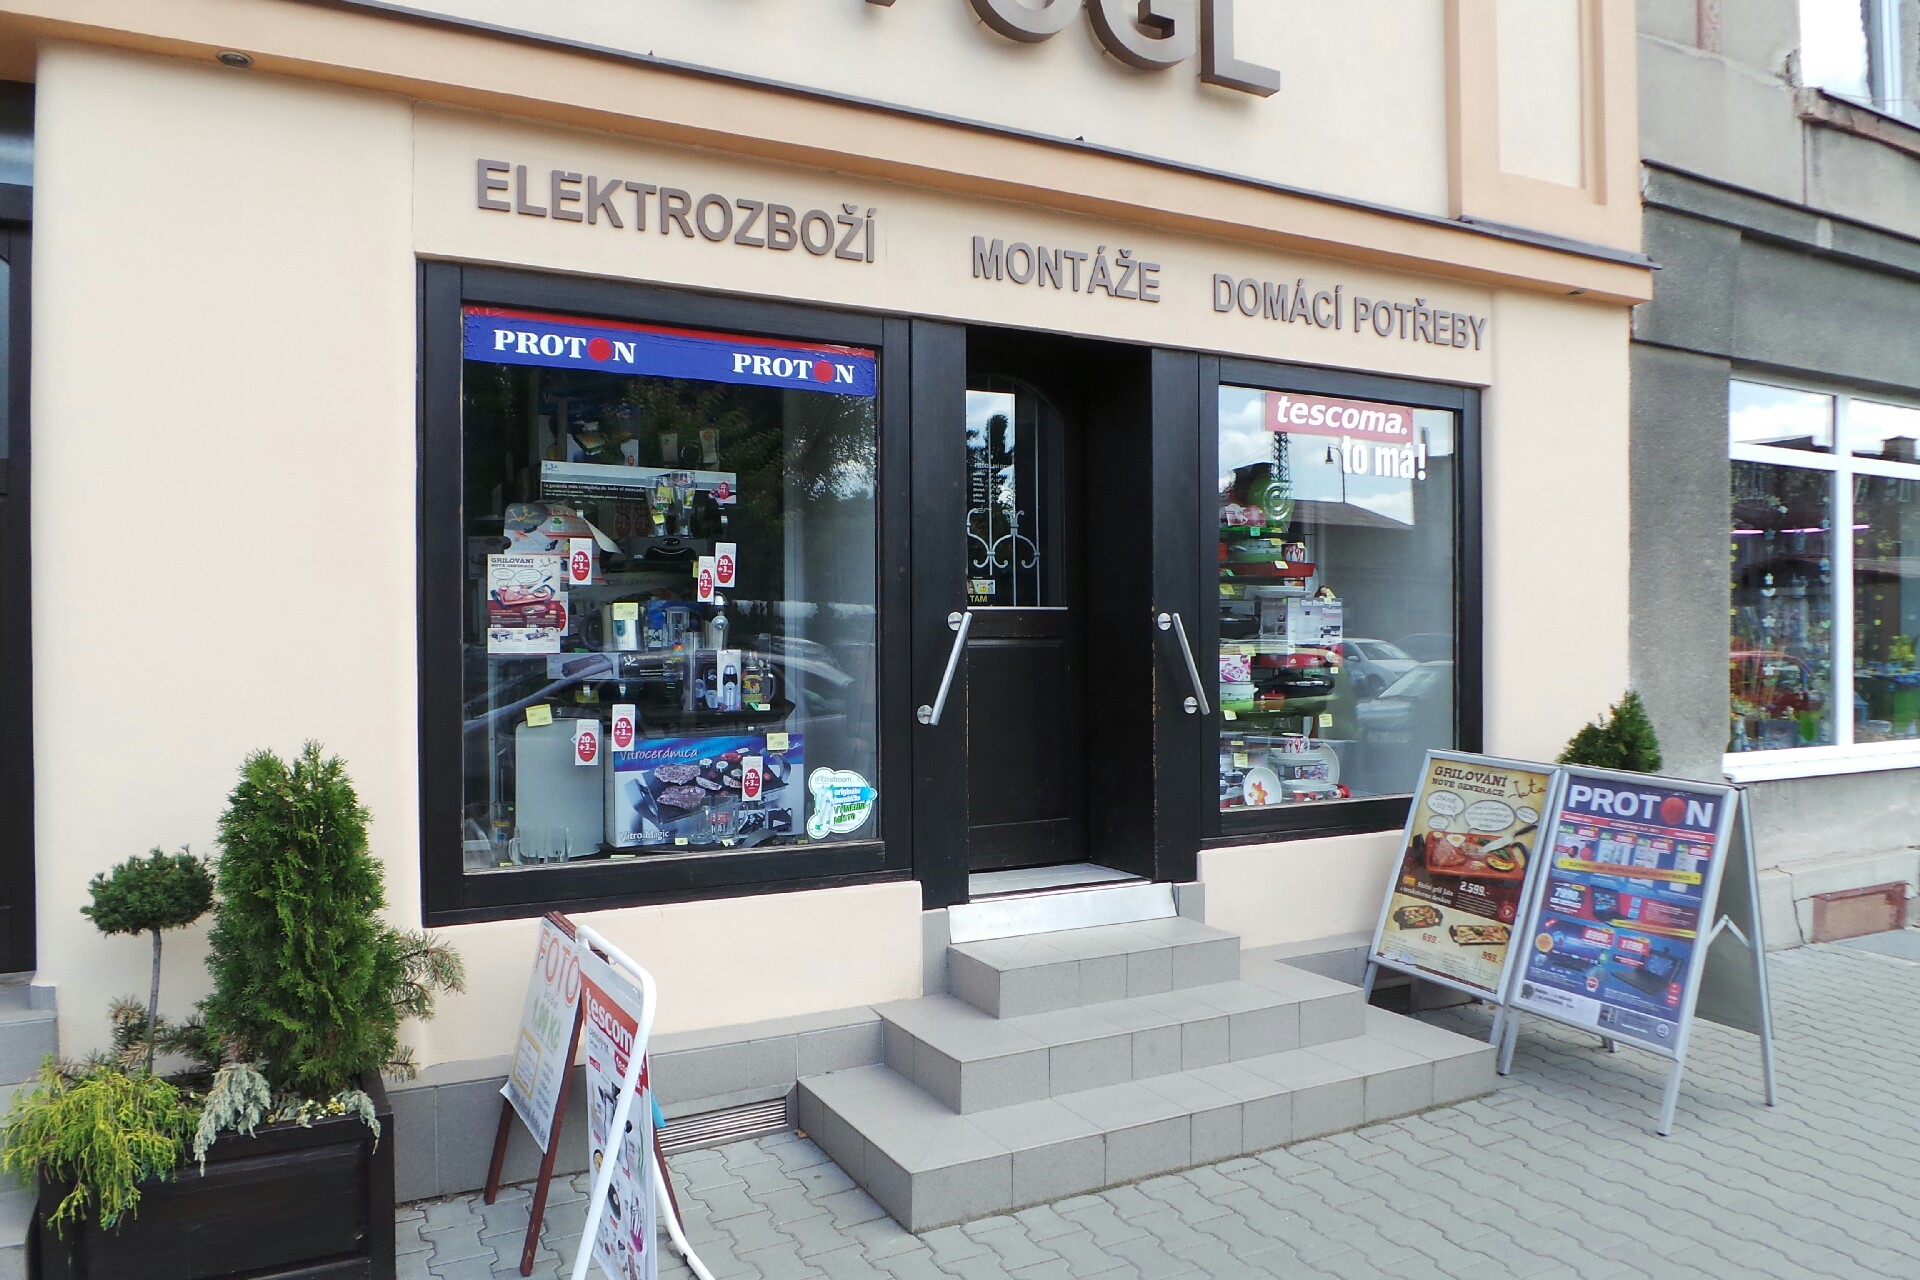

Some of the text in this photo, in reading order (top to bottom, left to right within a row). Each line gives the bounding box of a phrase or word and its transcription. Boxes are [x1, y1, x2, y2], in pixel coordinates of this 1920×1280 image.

[866, 0, 1281, 98] GL
[477, 157, 877, 264] ELEKTROZBOŽÍ
[971, 236, 1161, 303] MONTÁŽE
[1212, 273, 1489, 351] DOMÁCÍ POTŘEBY
[492, 328, 637, 365] PROTON
[732, 352, 855, 385] PROTON
[1276, 395, 1408, 436] tescoma.
[1341, 435, 1427, 481] to má!
[1457, 781, 1505, 797] GENERACE
[1567, 784, 1714, 828] PROTON
[619, 831, 643, 843] Vitro
[535, 927, 580, 1006] FOTO
[585, 986, 634, 1055] tescom
